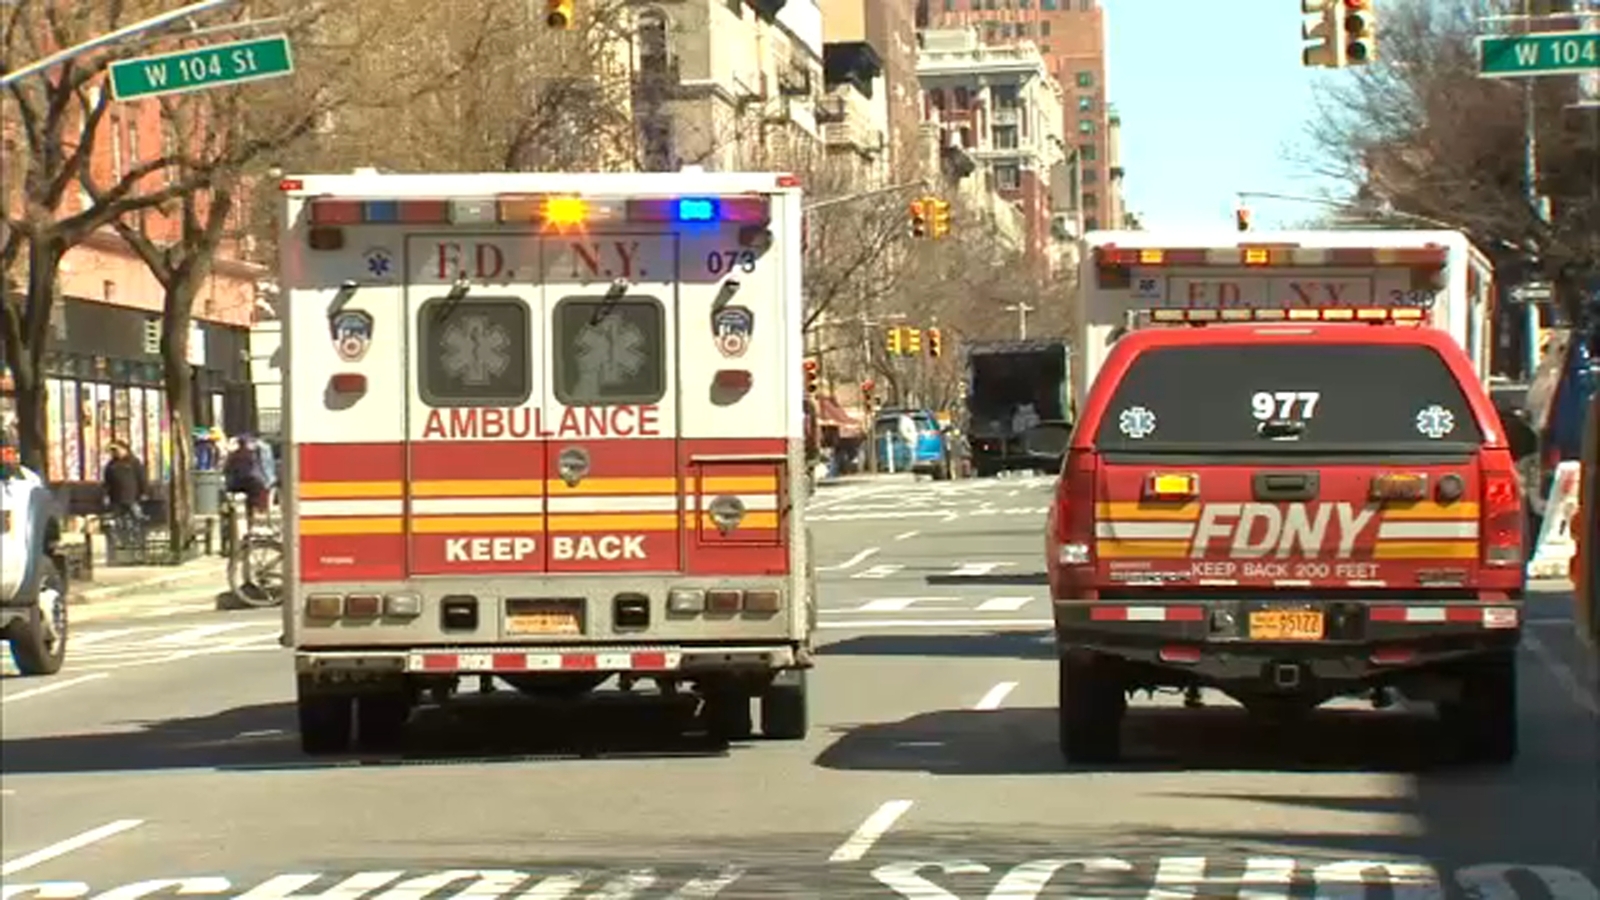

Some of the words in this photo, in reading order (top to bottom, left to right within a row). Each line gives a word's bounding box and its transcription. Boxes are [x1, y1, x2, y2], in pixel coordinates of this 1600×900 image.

[1514, 42, 1539, 66] W
[1550, 39, 1596, 64] 104
[145, 63, 167, 88] W
[180, 54, 222, 82] 104
[231, 47, 258, 73] St
[570, 241, 648, 277] N.Y.
[707, 249, 756, 274] 073
[1251, 391, 1320, 420] 977
[422, 405, 660, 438] AMBULANCE
[1190, 502, 1376, 559] FDNY
[445, 538, 536, 561] KEEP
[552, 535, 647, 560] BACK
[1191, 562, 1237, 577] KEEP
[1243, 562, 1290, 578] BACK
[1295, 563, 1330, 578] 200
[1336, 563, 1380, 579] FEET
